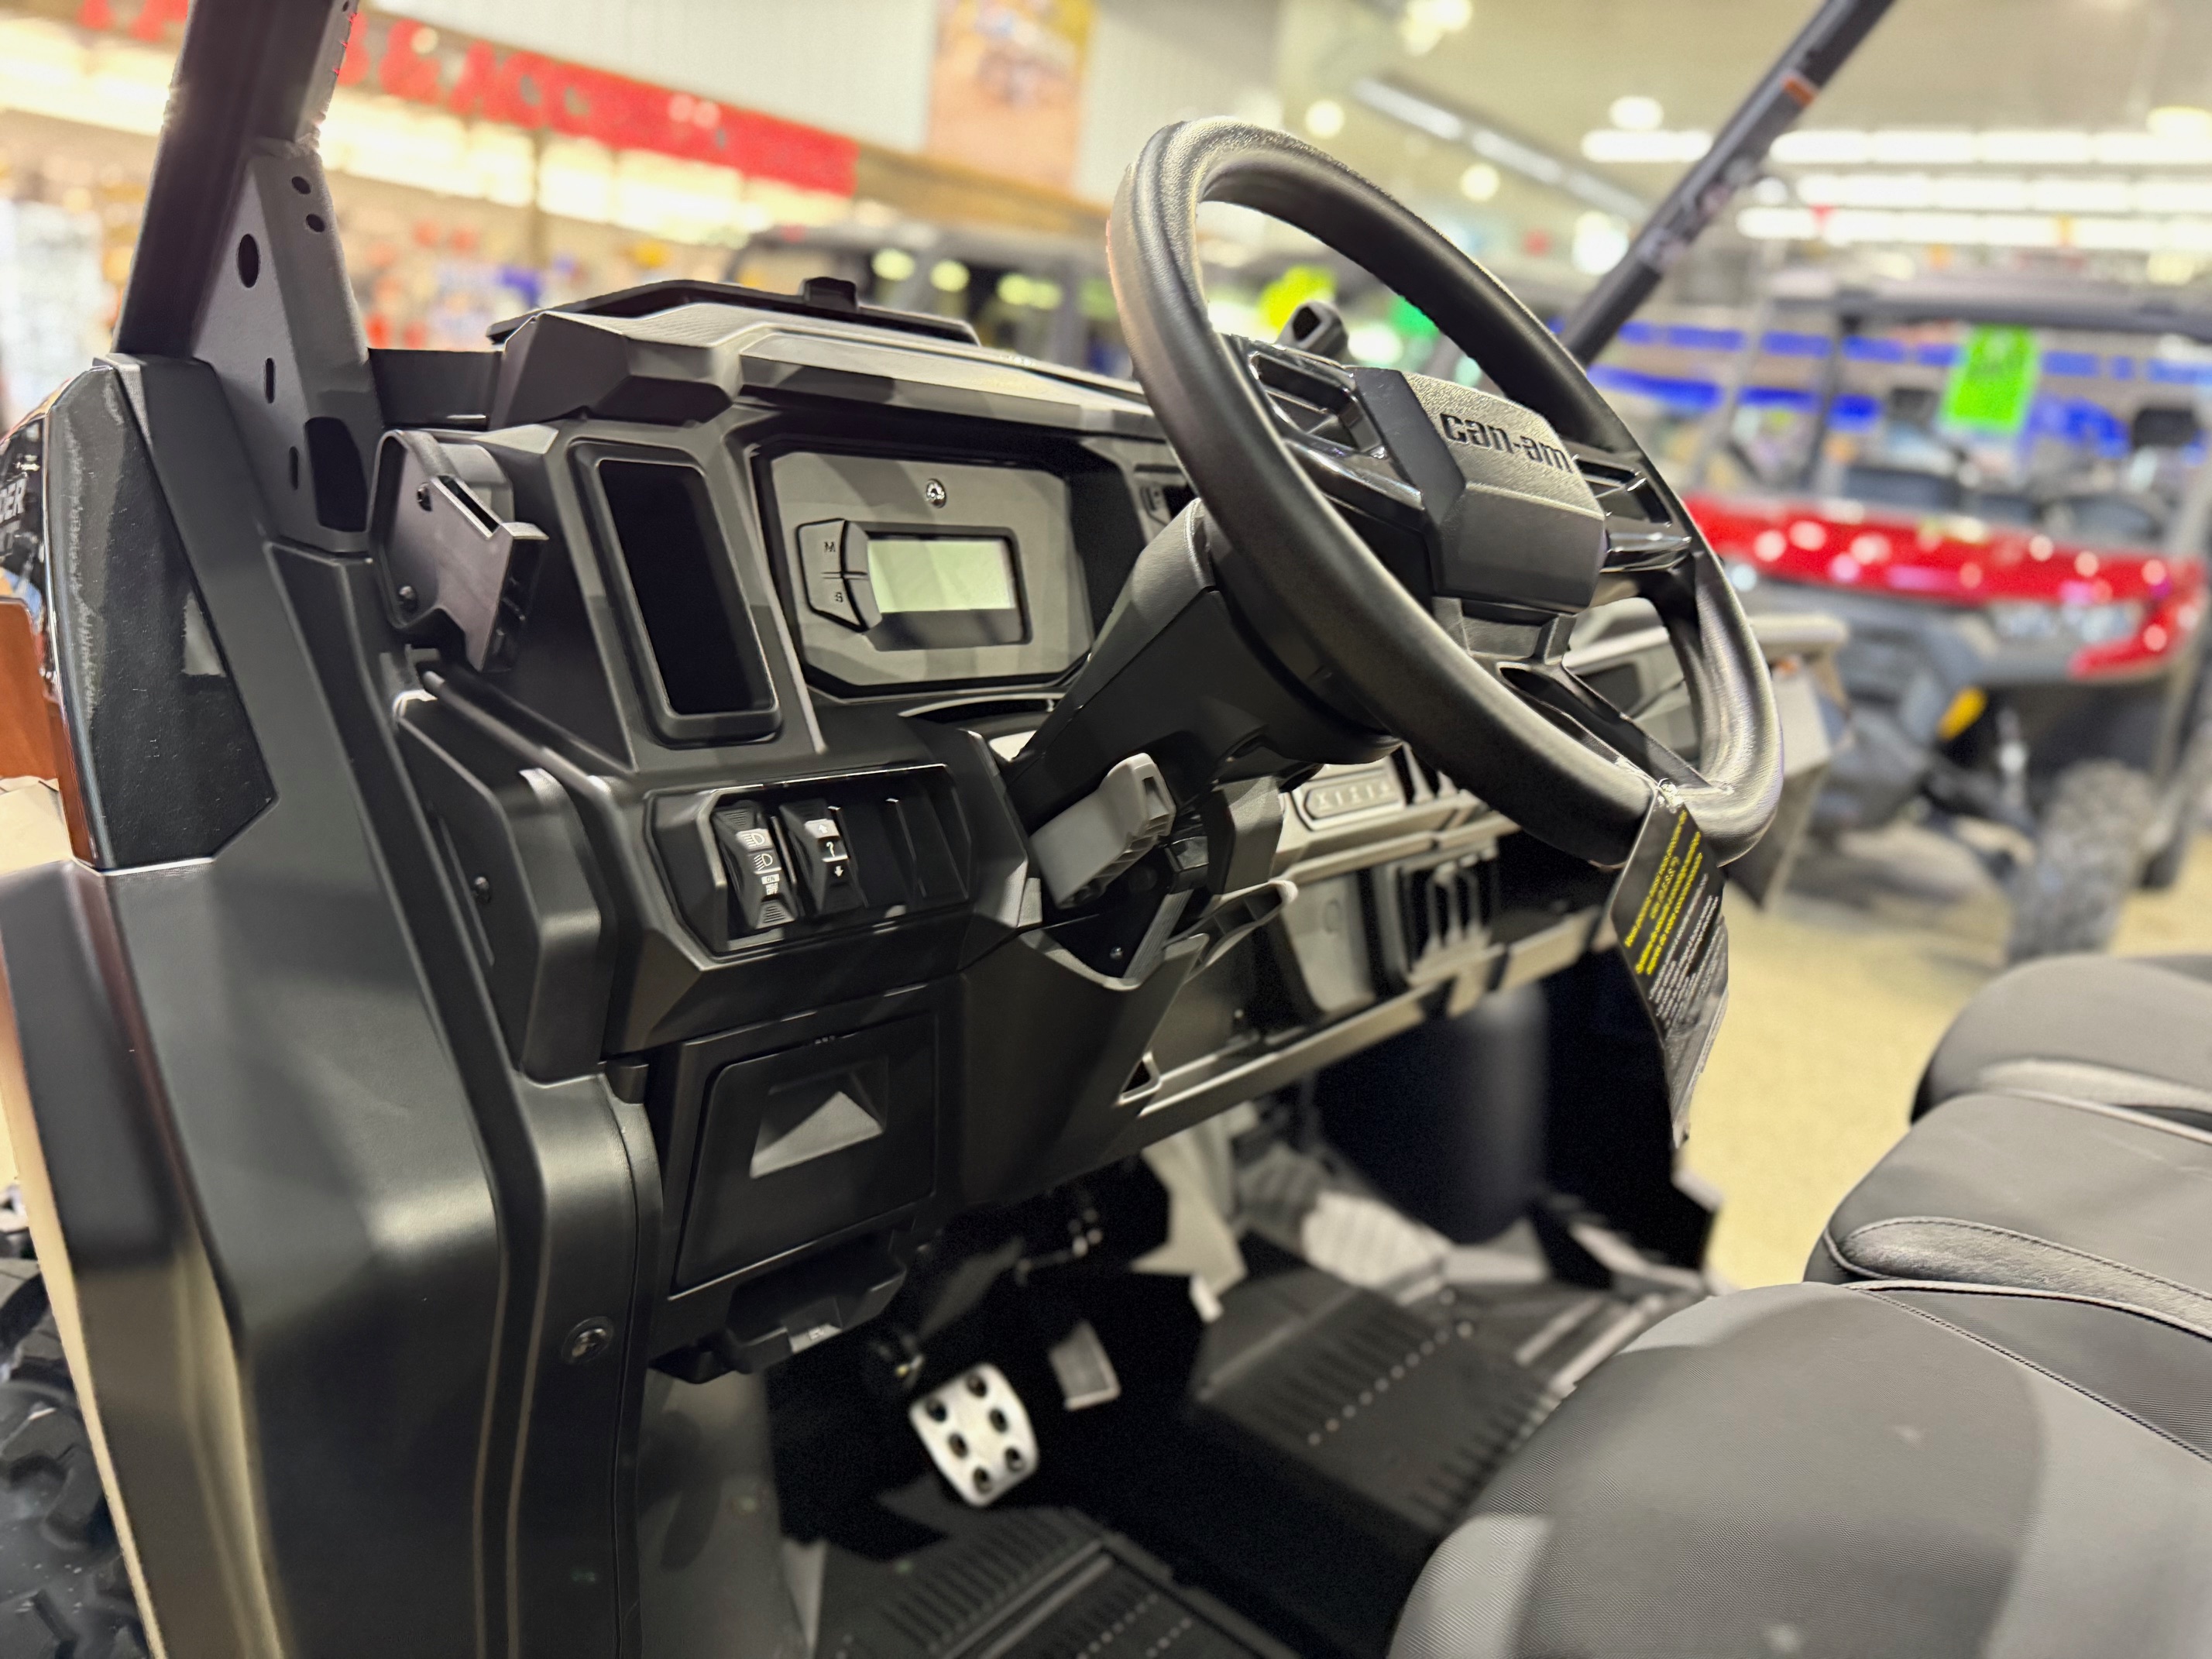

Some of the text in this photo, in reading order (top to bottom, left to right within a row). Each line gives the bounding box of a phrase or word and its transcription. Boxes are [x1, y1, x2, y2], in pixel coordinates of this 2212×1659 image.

[1440, 413, 1574, 474] can-am
[823, 541, 836, 552] M
[834, 592, 844, 603] S
